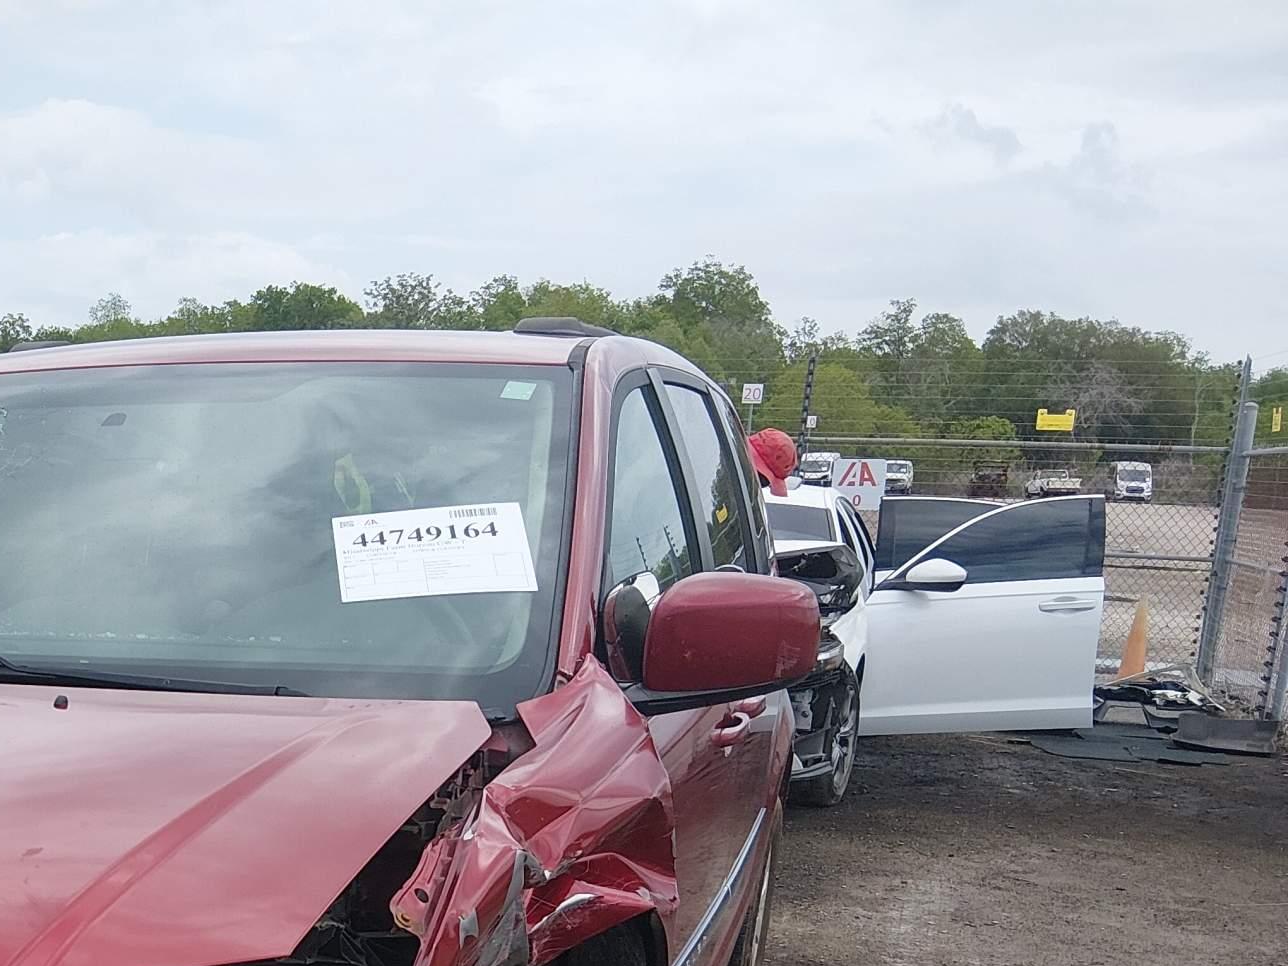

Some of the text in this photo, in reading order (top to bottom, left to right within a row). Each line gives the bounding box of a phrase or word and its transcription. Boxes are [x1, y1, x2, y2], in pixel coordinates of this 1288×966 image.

[743, 387, 762, 400] 20
[853, 494, 861, 507] 0
[352, 521, 499, 547] 44749164
